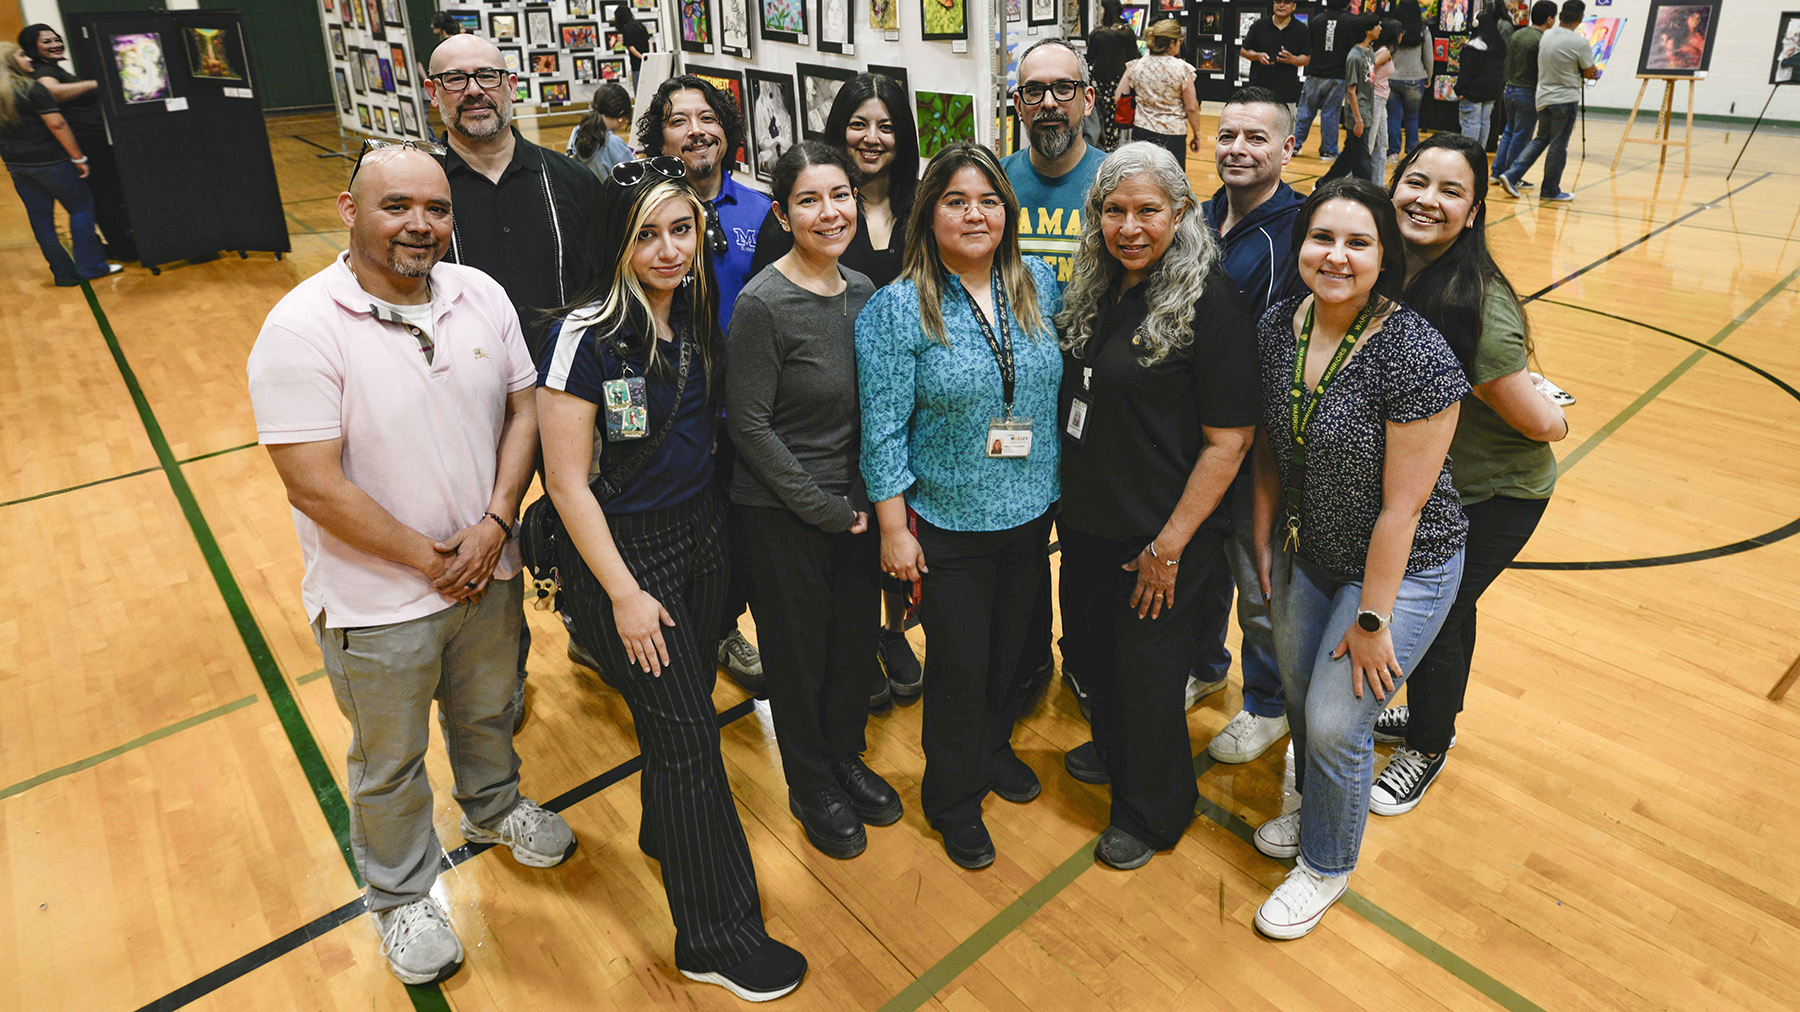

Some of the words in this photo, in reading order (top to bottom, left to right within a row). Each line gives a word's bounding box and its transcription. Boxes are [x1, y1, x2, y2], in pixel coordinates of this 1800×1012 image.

[733, 227, 757, 247] M
[1295, 346, 1306, 383] WARRIORS
[1323, 347, 1348, 381] WARRIORS
